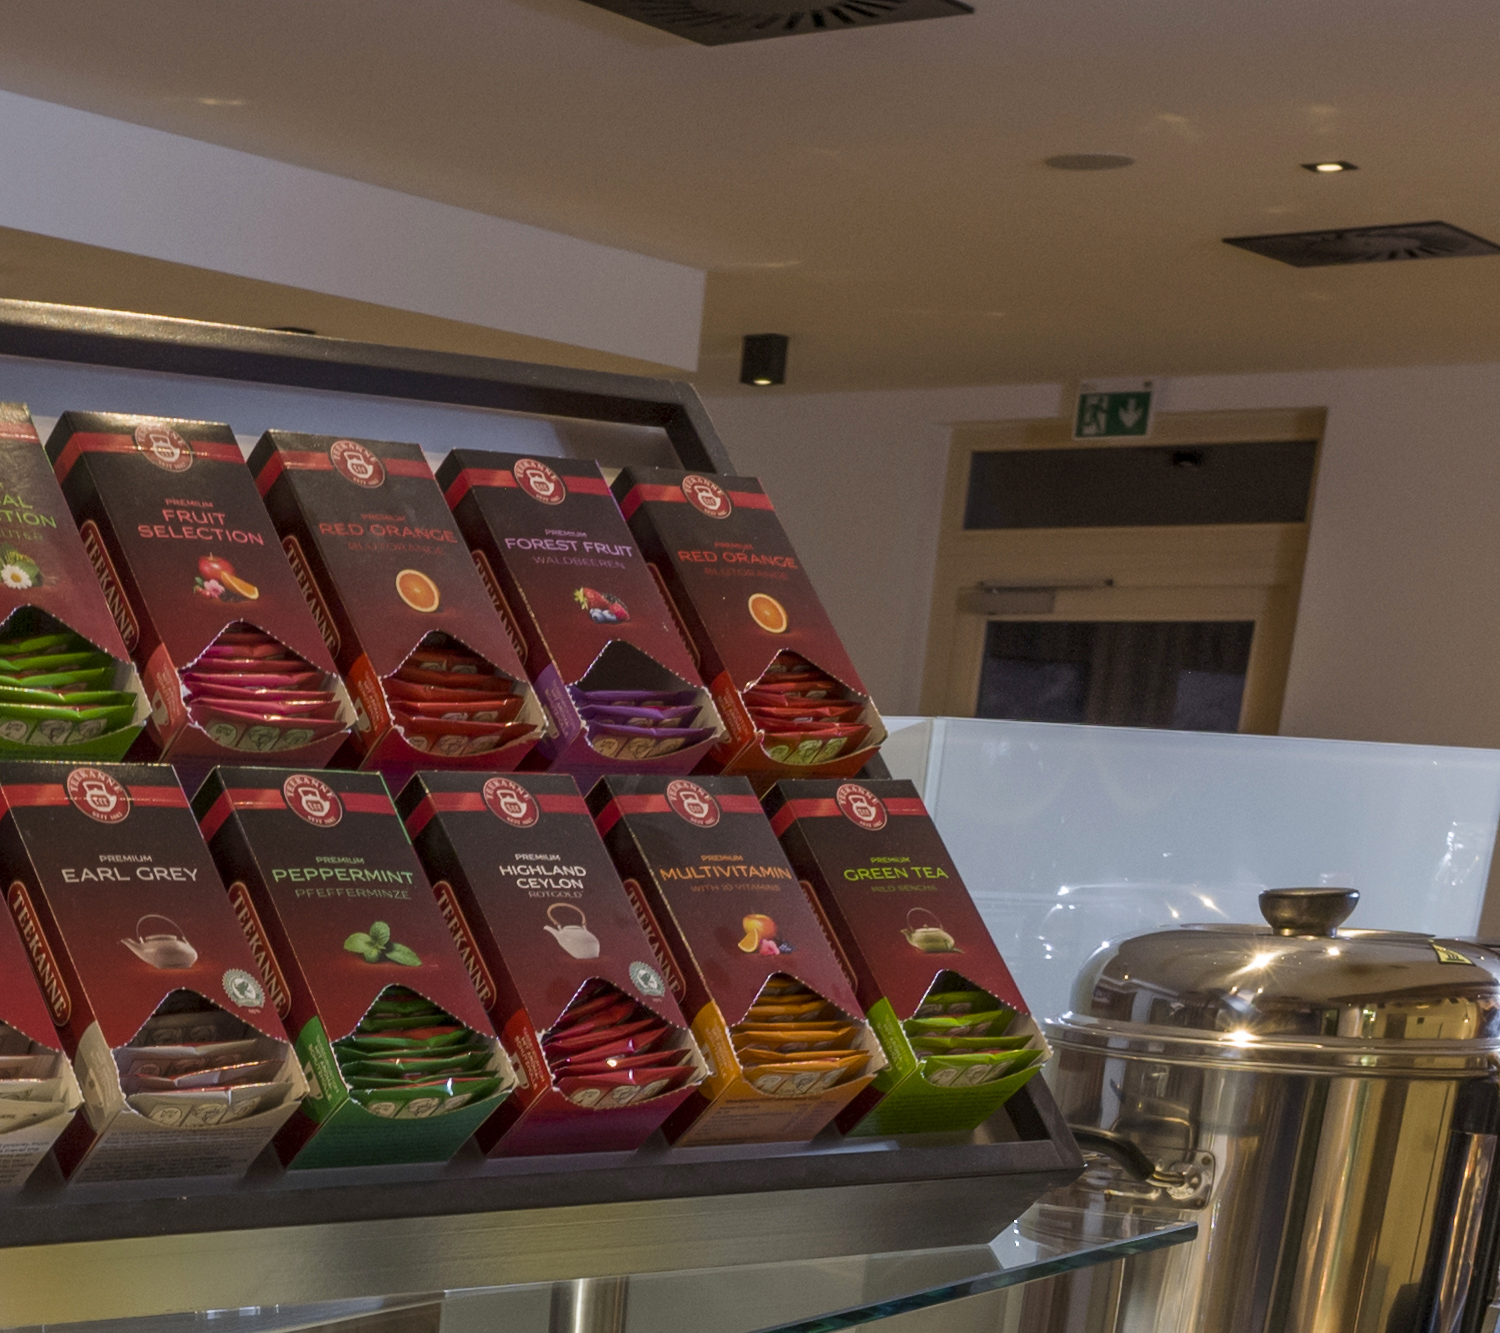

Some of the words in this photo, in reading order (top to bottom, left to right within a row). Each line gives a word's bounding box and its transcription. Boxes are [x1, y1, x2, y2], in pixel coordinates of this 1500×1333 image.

[332, 441, 379, 463] TEEKANNE
[516, 459, 559, 482] TEEKANNE
[165, 498, 213, 509] PREMIUM
[162, 509, 226, 525] FRUIT
[138, 525, 264, 545] SELECTION
[319, 523, 363, 536] RED
[370, 524, 458, 543] ORANGE
[545, 528, 587, 538] PREMIUM
[504, 538, 578, 551] FOREST
[583, 541, 632, 557] FRUIT
[532, 556, 626, 570] WALDBEEREN
[678, 551, 717, 563] RED
[722, 551, 798, 569] ORANGE
[85, 528, 135, 646] TEEKANNE
[287, 543, 335, 651] TEEKANNE
[69, 769, 123, 794] TEEKANNE
[287, 776, 336, 799] TEEKANNE
[486, 779, 531, 801] TEEKANNE
[99, 855, 152, 863] PREMIUM
[315, 856, 365, 864] PREMIUM
[515, 853, 560, 861] PREMIUM
[62, 869, 130, 883] EARL
[136, 867, 198, 882] GREY
[272, 869, 414, 884] PEPPERMINT
[499, 865, 587, 876] HIGHLAND
[660, 865, 793, 880] MULTIVITAMIN
[844, 867, 909, 881] GREEN
[911, 866, 949, 879] TEA
[516, 878, 584, 889] CEYLON
[295, 888, 412, 900] PFEFFERMINZE
[12, 890, 66, 1017] TEEKANNE
[232, 890, 286, 1013] TEEKANNE
[437, 890, 492, 1006] TEEKANNE
